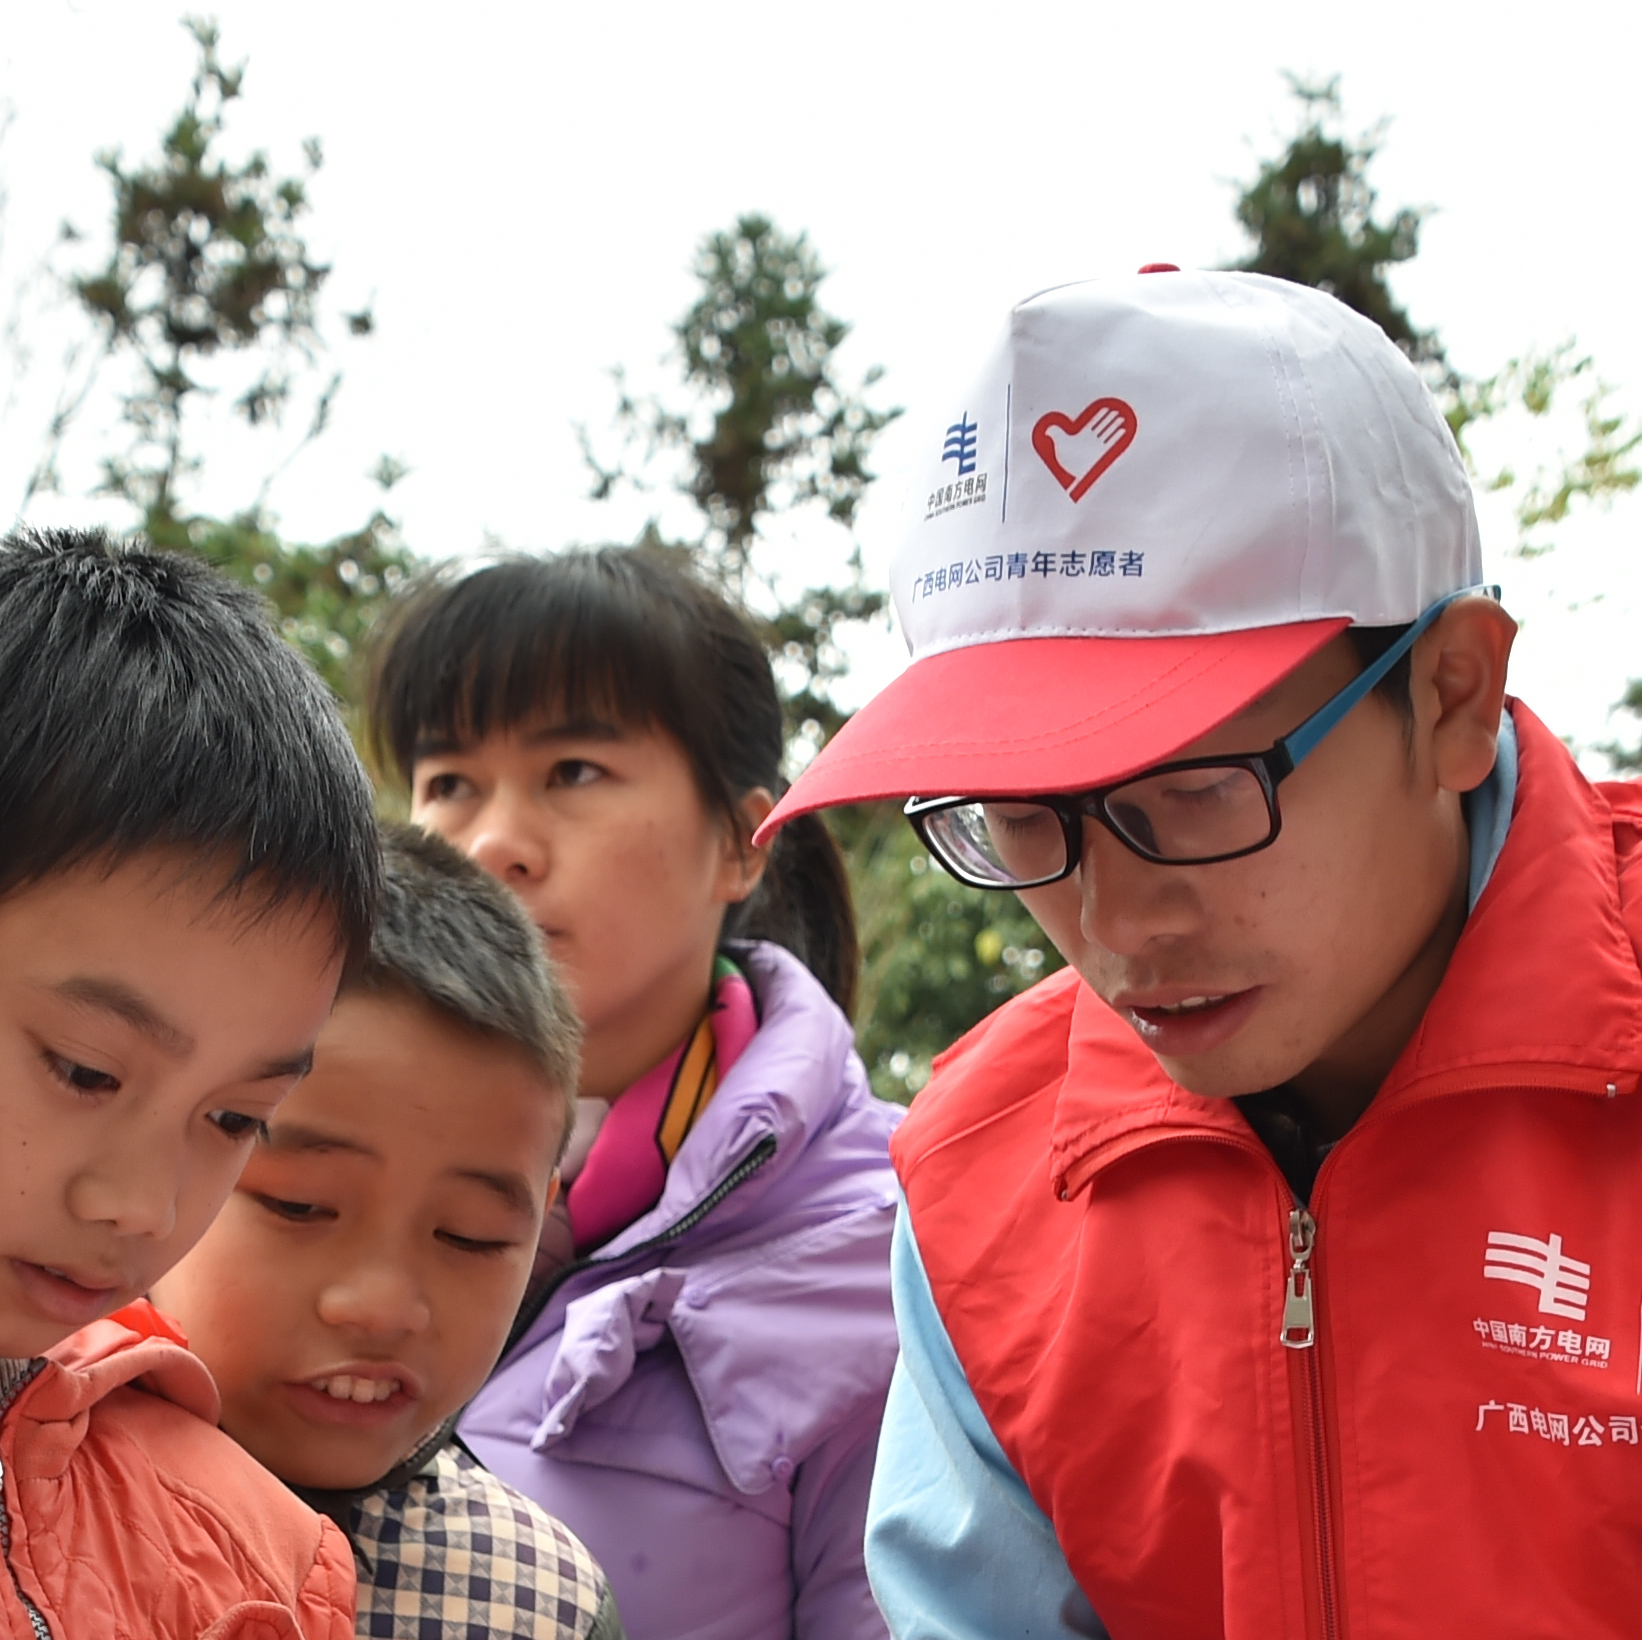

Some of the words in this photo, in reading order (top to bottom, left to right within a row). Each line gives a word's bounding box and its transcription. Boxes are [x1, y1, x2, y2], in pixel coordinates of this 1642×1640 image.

[927, 472, 988, 512] 中国南方电网
[912, 549, 1145, 603] 广西电网公司青年志愿者
[1473, 1317, 1611, 1360] 中国南方电网
[1539, 1351, 1579, 1364] POWER
[1581, 1358, 1608, 1369] GRID
